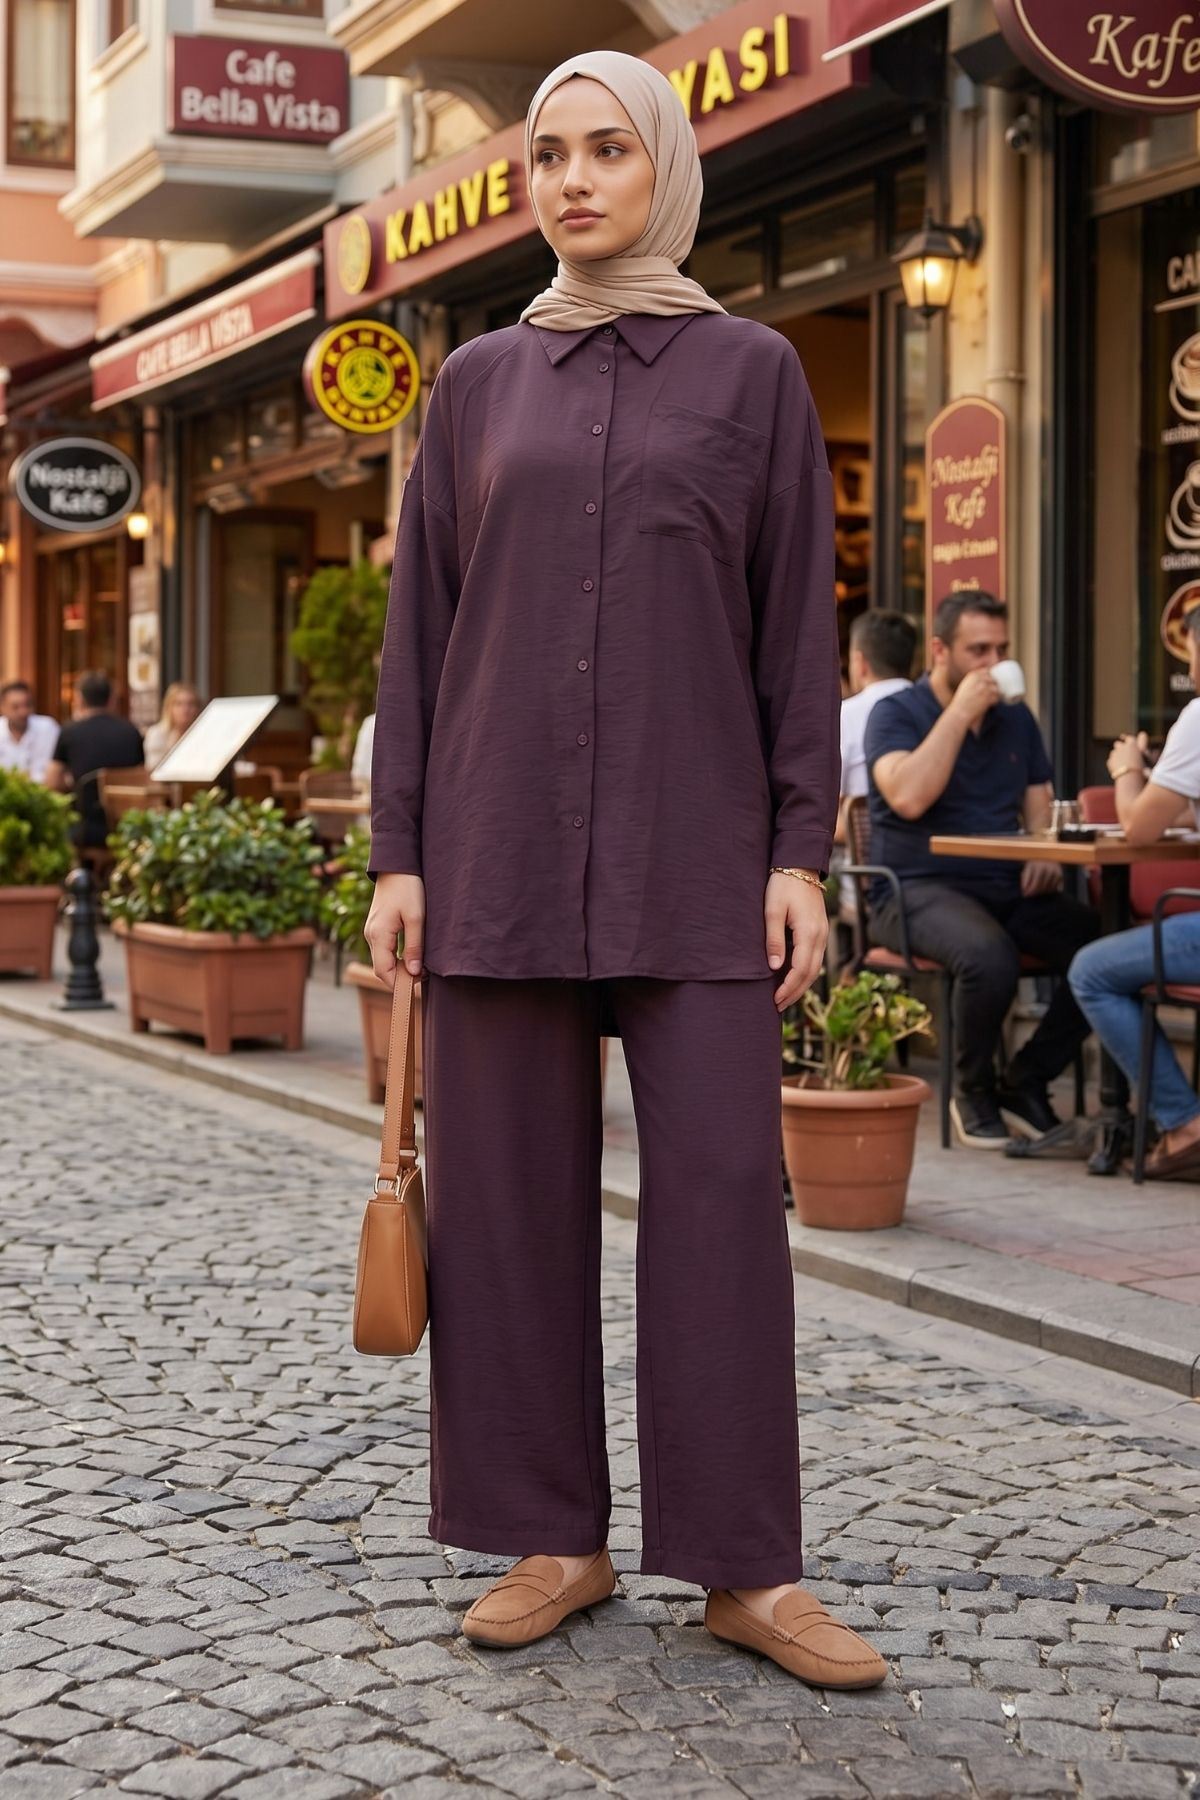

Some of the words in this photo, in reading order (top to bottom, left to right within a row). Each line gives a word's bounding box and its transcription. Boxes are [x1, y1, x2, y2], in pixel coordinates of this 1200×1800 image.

[225, 49, 296, 89] Cafe
[1087, 13, 1200, 89] Kafe
[181, 86, 258, 126] Bella
[263, 92, 341, 133] Vista
[385, 157, 511, 264] KAHVE
[1166, 251, 1200, 293] CA
[325, 330, 408, 369] KAHVE
[28, 461, 127, 495] Nostalji
[930, 444, 999, 488] Nostalji
[49, 487, 109, 516] Kafe
[944, 486, 987, 530] Kafe
